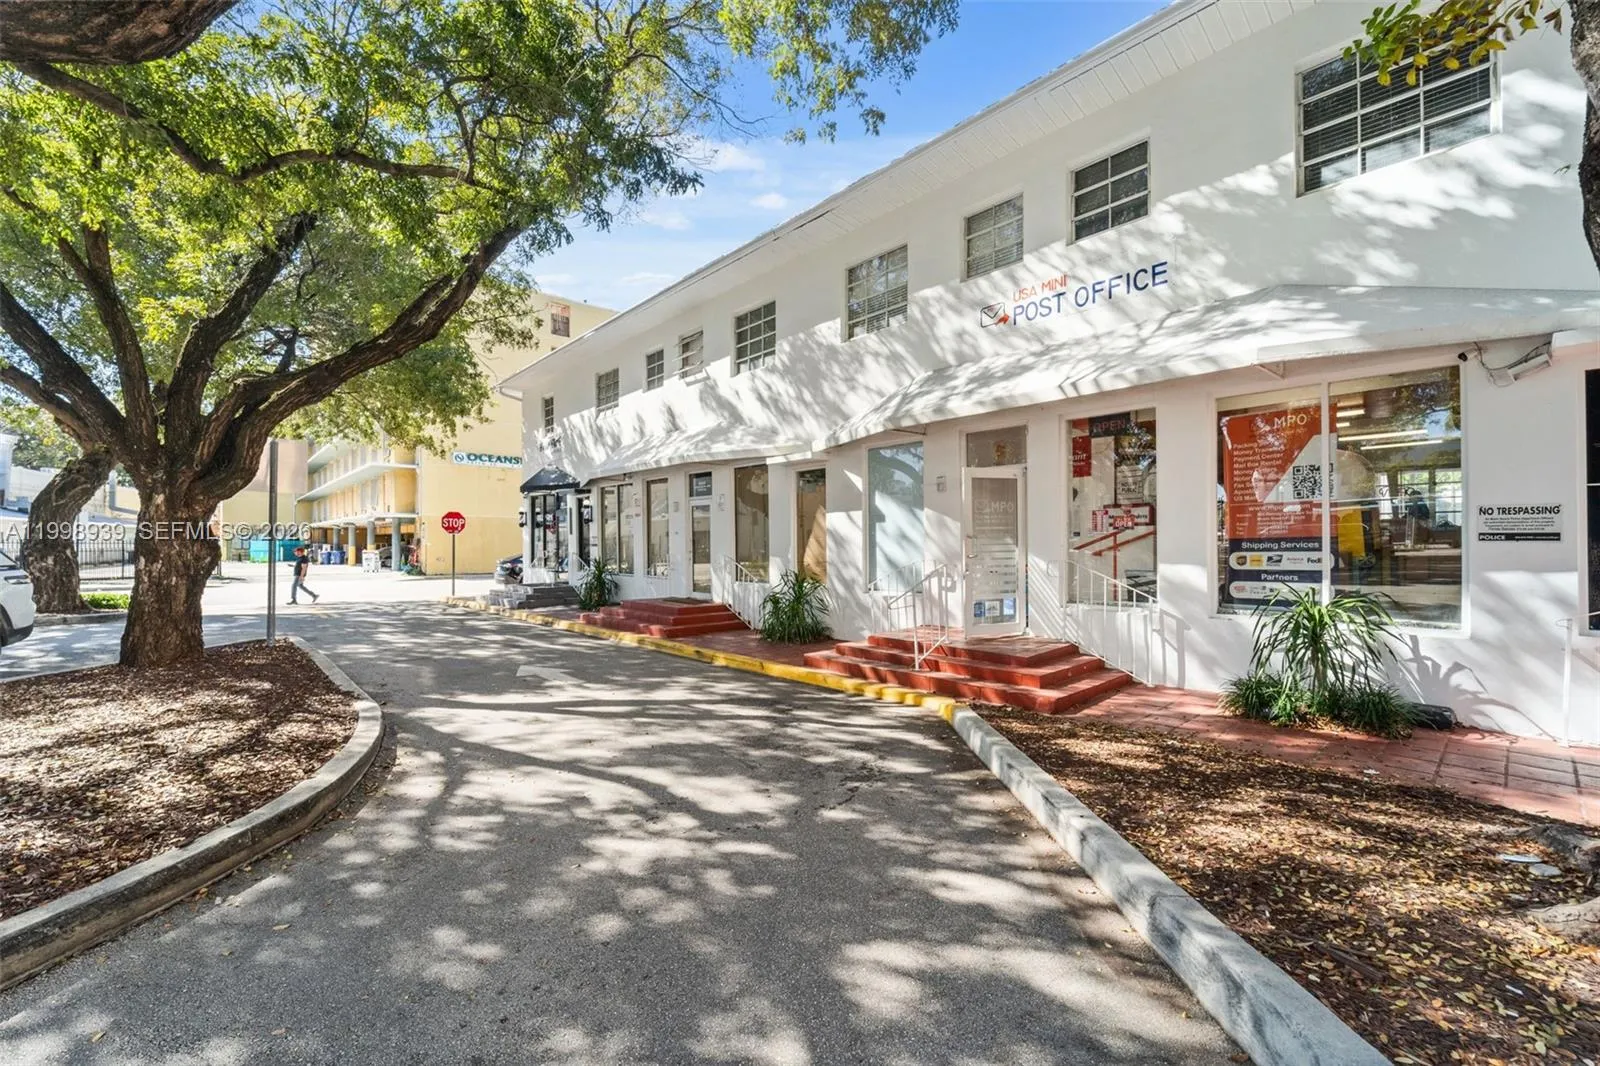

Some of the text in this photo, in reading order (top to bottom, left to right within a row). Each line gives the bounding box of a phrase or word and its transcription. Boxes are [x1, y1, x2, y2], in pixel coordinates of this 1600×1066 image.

[1014, 274, 1068, 303] USA MINI
[1013, 261, 1169, 326] POST OFFICE
[1094, 418, 1126, 432] OPEN
[1273, 414, 1307, 429] MPO
[1233, 448, 1253, 456] Money
[1233, 454, 1260, 463] Payment
[991, 501, 1014, 513] MPO
[1479, 506, 1560, 515] NO TRESPASSING
[442, 518, 465, 528] STOP
[1241, 541, 1319, 550] Shipping Services
[1306, 556, 1323, 564] FedE
[1261, 573, 1299, 581] Partners
